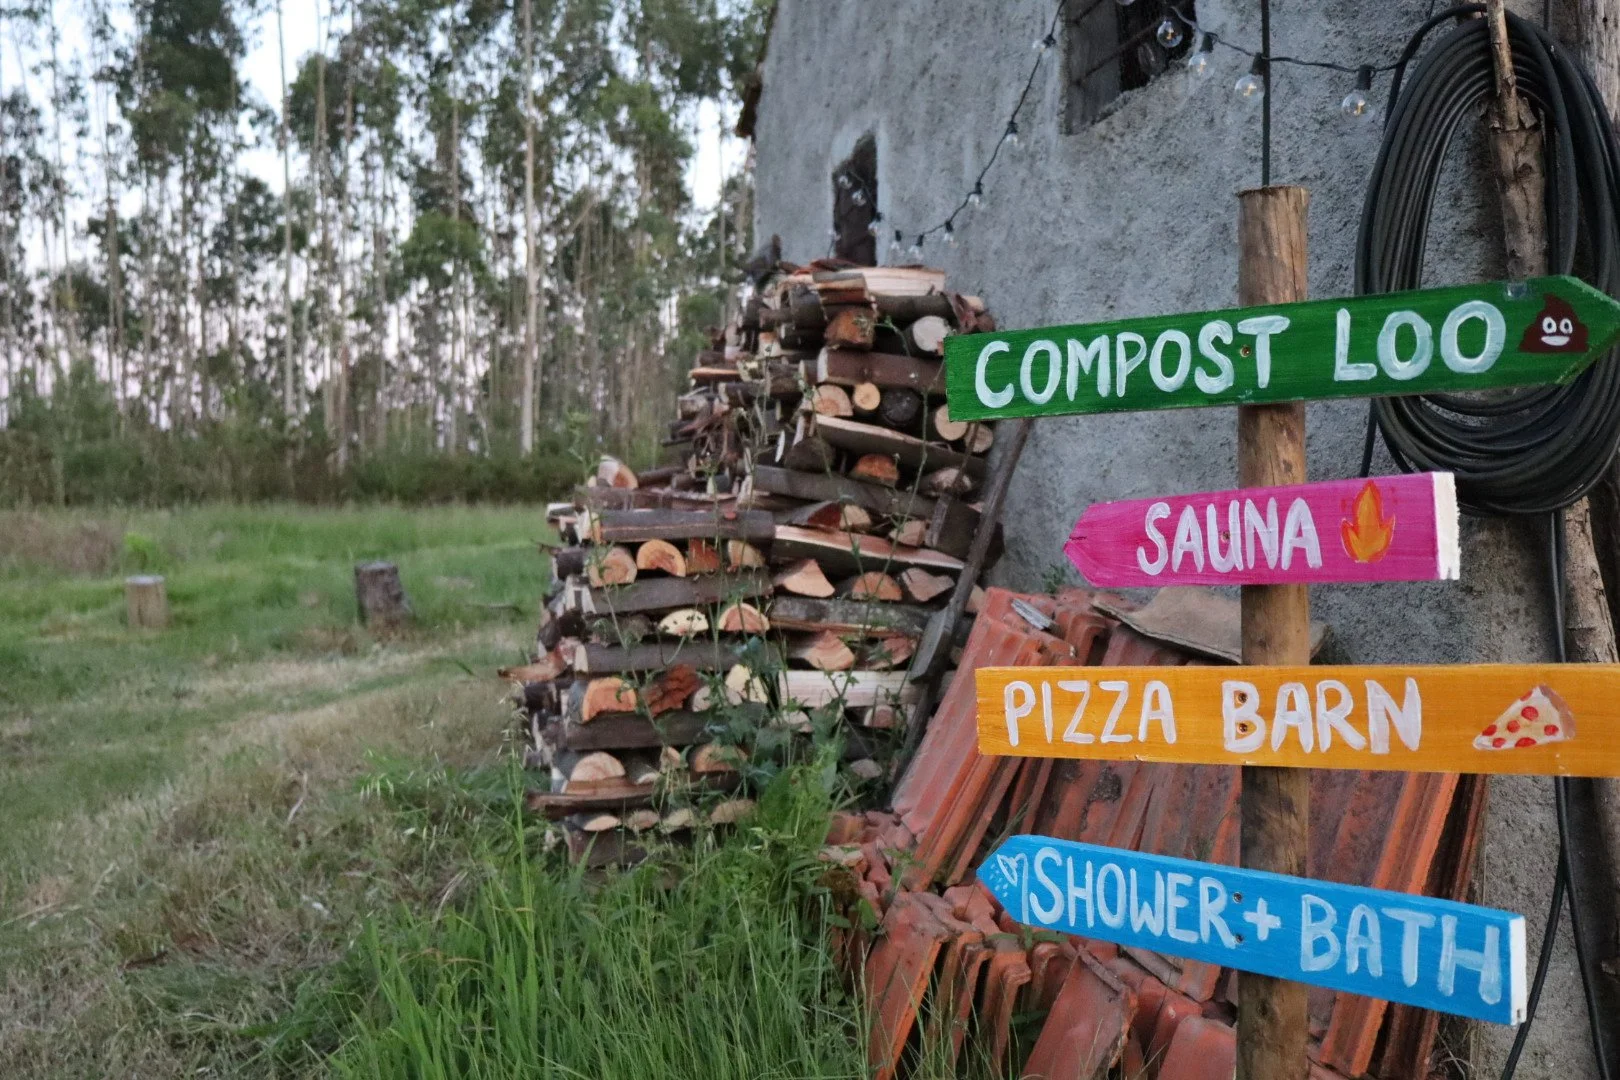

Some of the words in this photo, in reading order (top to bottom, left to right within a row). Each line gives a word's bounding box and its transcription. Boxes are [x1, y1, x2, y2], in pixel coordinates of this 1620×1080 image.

[975, 315, 1290, 408] COMPOST
[1334, 300, 1507, 382] LOO
[1137, 497, 1322, 576] SAUNA
[1004, 679, 1177, 747] PIZZA
[1222, 677, 1422, 754] BARN
[1300, 894, 1501, 1005] BATH
